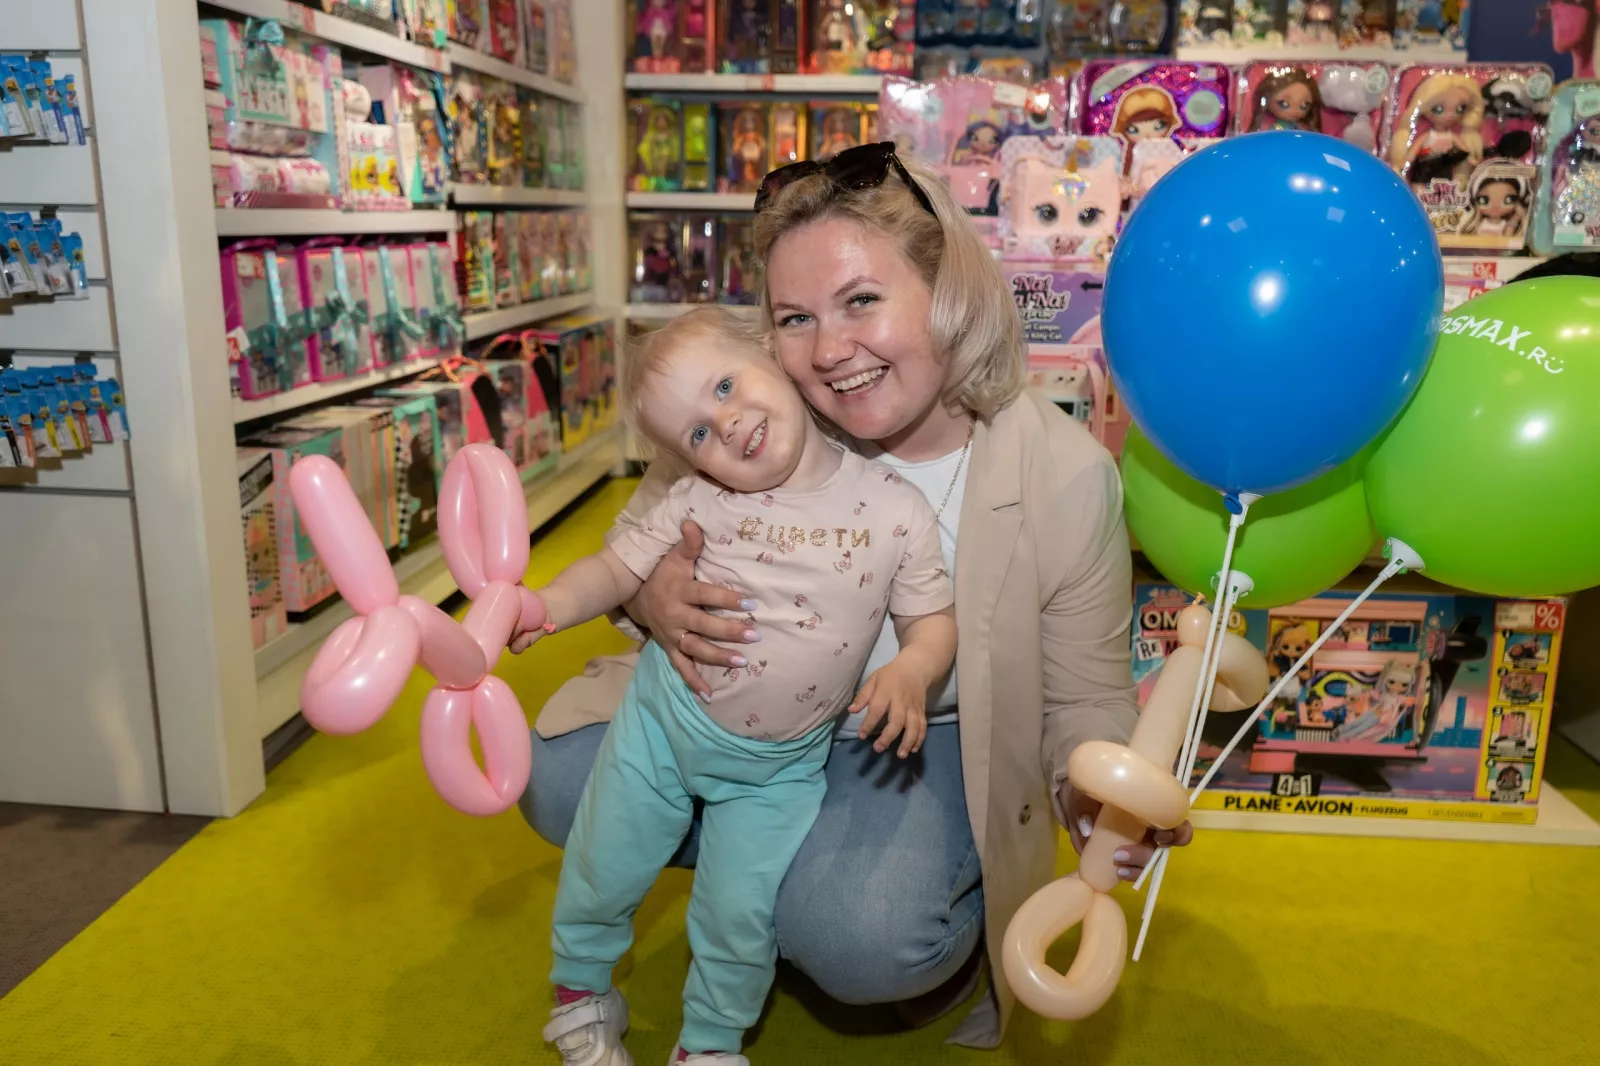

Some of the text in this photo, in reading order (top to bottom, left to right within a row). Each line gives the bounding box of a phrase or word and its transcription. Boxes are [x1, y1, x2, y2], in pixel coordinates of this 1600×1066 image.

[1012, 275, 1052, 291] Na!
[1031, 290, 1069, 309] Na!
[736, 516, 870, 549] #цвети
[1141, 608, 1180, 629] OM
[1224, 796, 1408, 815] PLANE AVION FLUGZEUG
